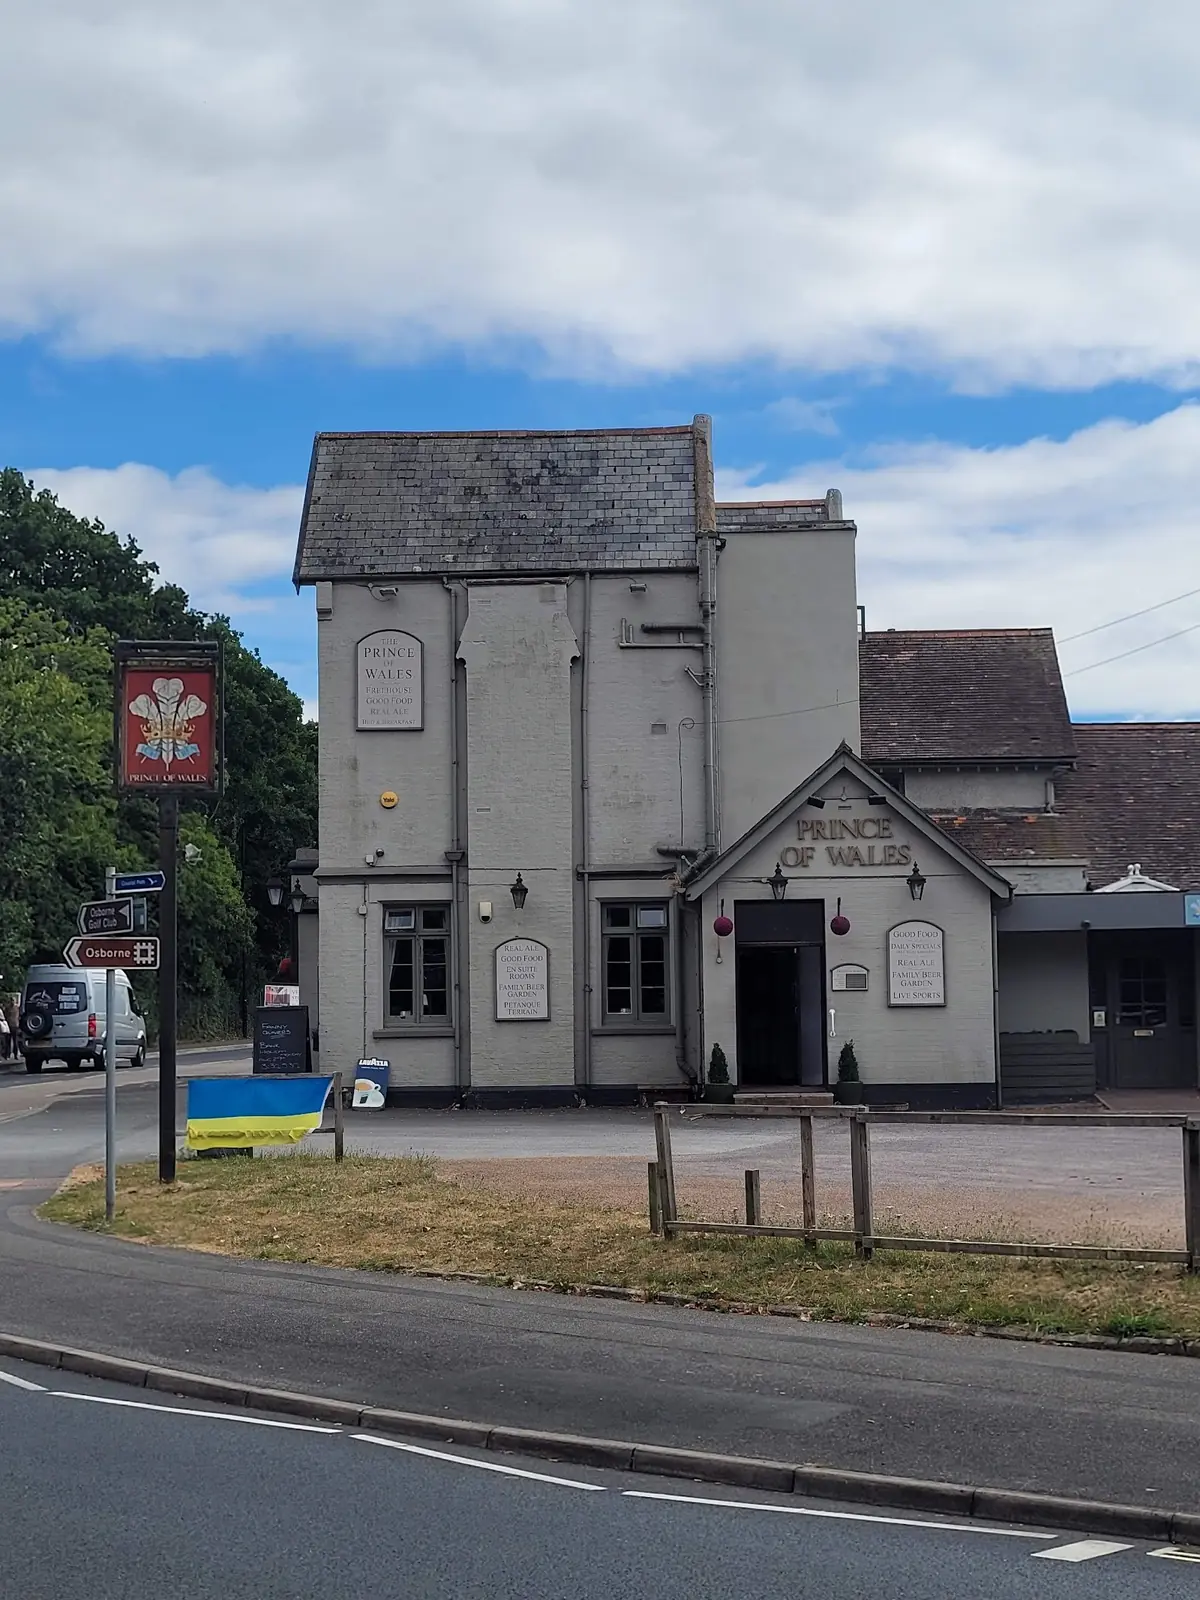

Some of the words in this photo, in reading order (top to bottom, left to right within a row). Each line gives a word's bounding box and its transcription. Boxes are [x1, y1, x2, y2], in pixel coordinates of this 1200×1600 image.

[364, 647, 415, 658] PRINCE
[365, 668, 412, 680] WALES
[129, 774, 159, 782] PRINCE
[796, 817, 894, 840] PRINCE
[780, 846, 816, 868] OF
[825, 844, 912, 867] WALES
[90, 908, 115, 918] Osborne
[88, 920, 101, 930] Golf
[103, 918, 117, 928] Club
[86, 948, 131, 958] Osborne
[359, 1058, 388, 1067] LAVAZZA
